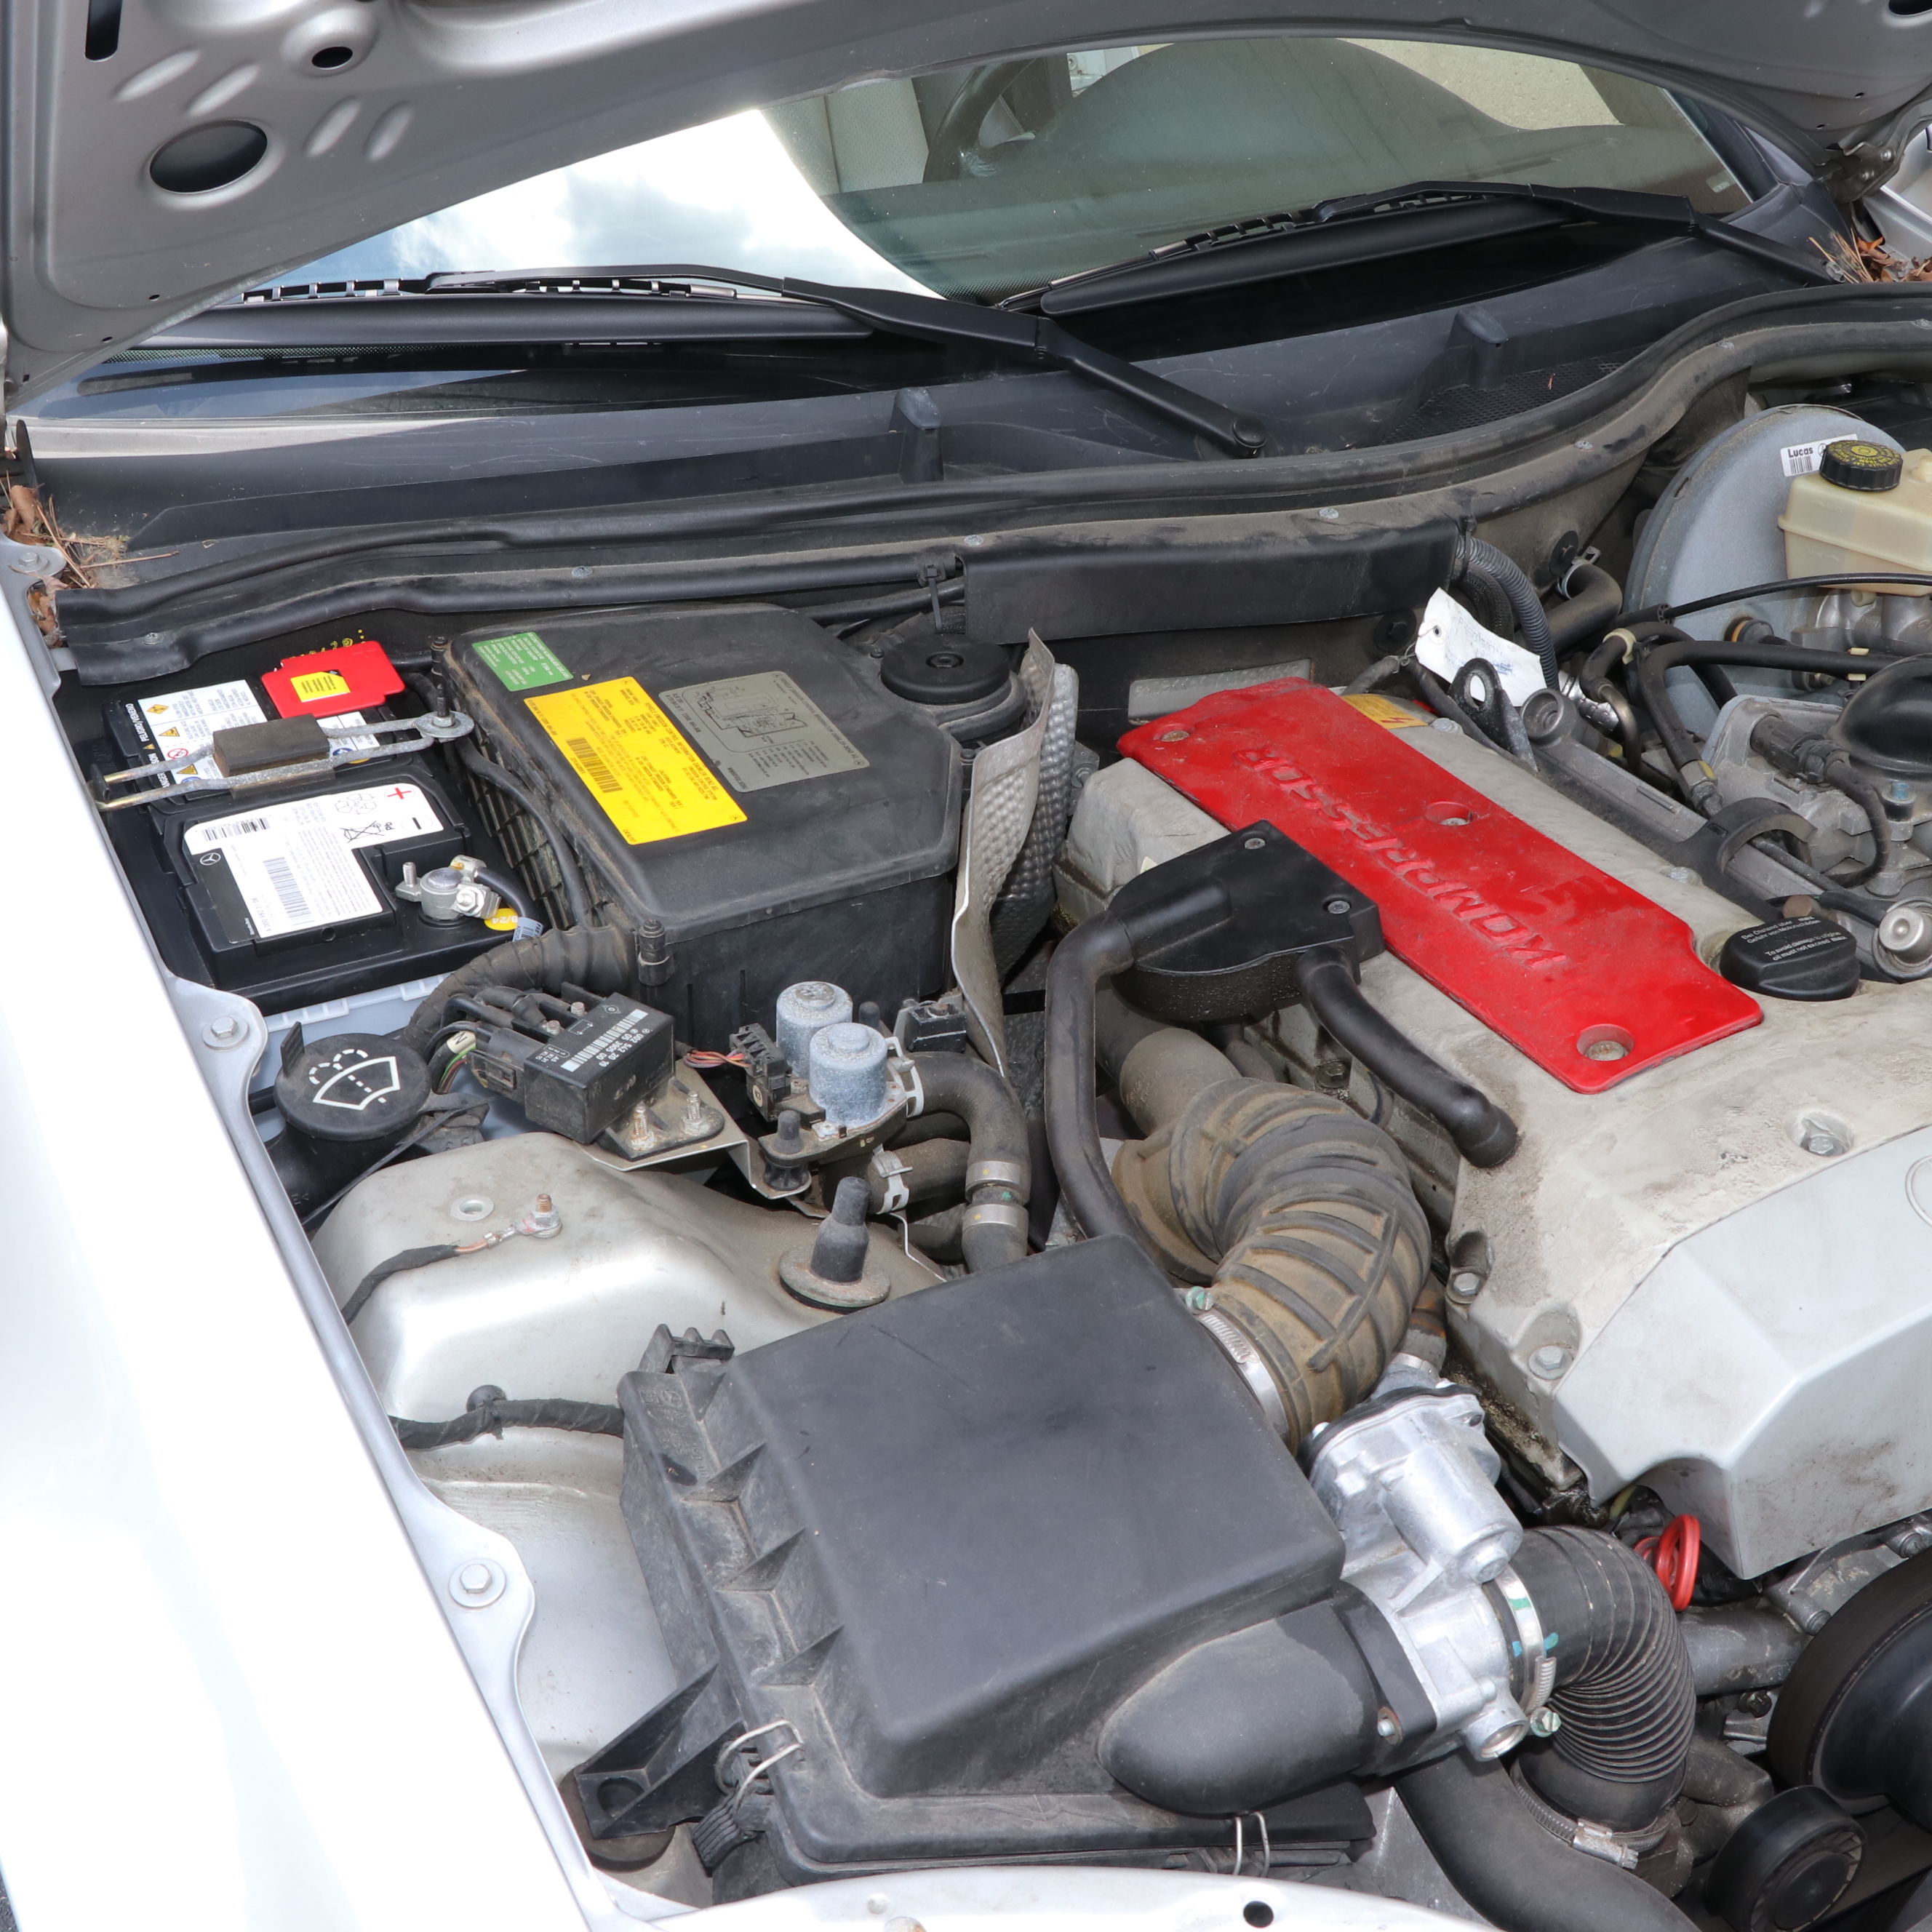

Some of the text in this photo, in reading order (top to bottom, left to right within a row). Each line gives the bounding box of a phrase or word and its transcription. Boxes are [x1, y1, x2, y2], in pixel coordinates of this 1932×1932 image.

[1787, 447, 1813, 458] Lucas
[126, 703, 149, 742] PELIGRO/VENENO
[644, 703, 656, 712] VEHICLE
[653, 714, 668, 727] EMISSION
[664, 728, 679, 741] CONTROL
[676, 742, 695, 761] INFORMATION
[1234, 746, 1568, 970] KOMPRESSOR
[491, 915, 518, 924] 8/24
[1747, 934, 1768, 943] Gefahr
[1776, 944, 1792, 954] avoid
[1792, 937, 1814, 947] damage
[1781, 949, 1797, 958] must
[1807, 939, 1830, 949] exceed
[453, 1031, 468, 1045] N
[630, 1033, 644, 1044] 002
[605, 1040, 623, 1053] 3905
[618, 1043, 632, 1053] 542
[596, 1053, 608, 1061] 00
[607, 1052, 619, 1061] 20
